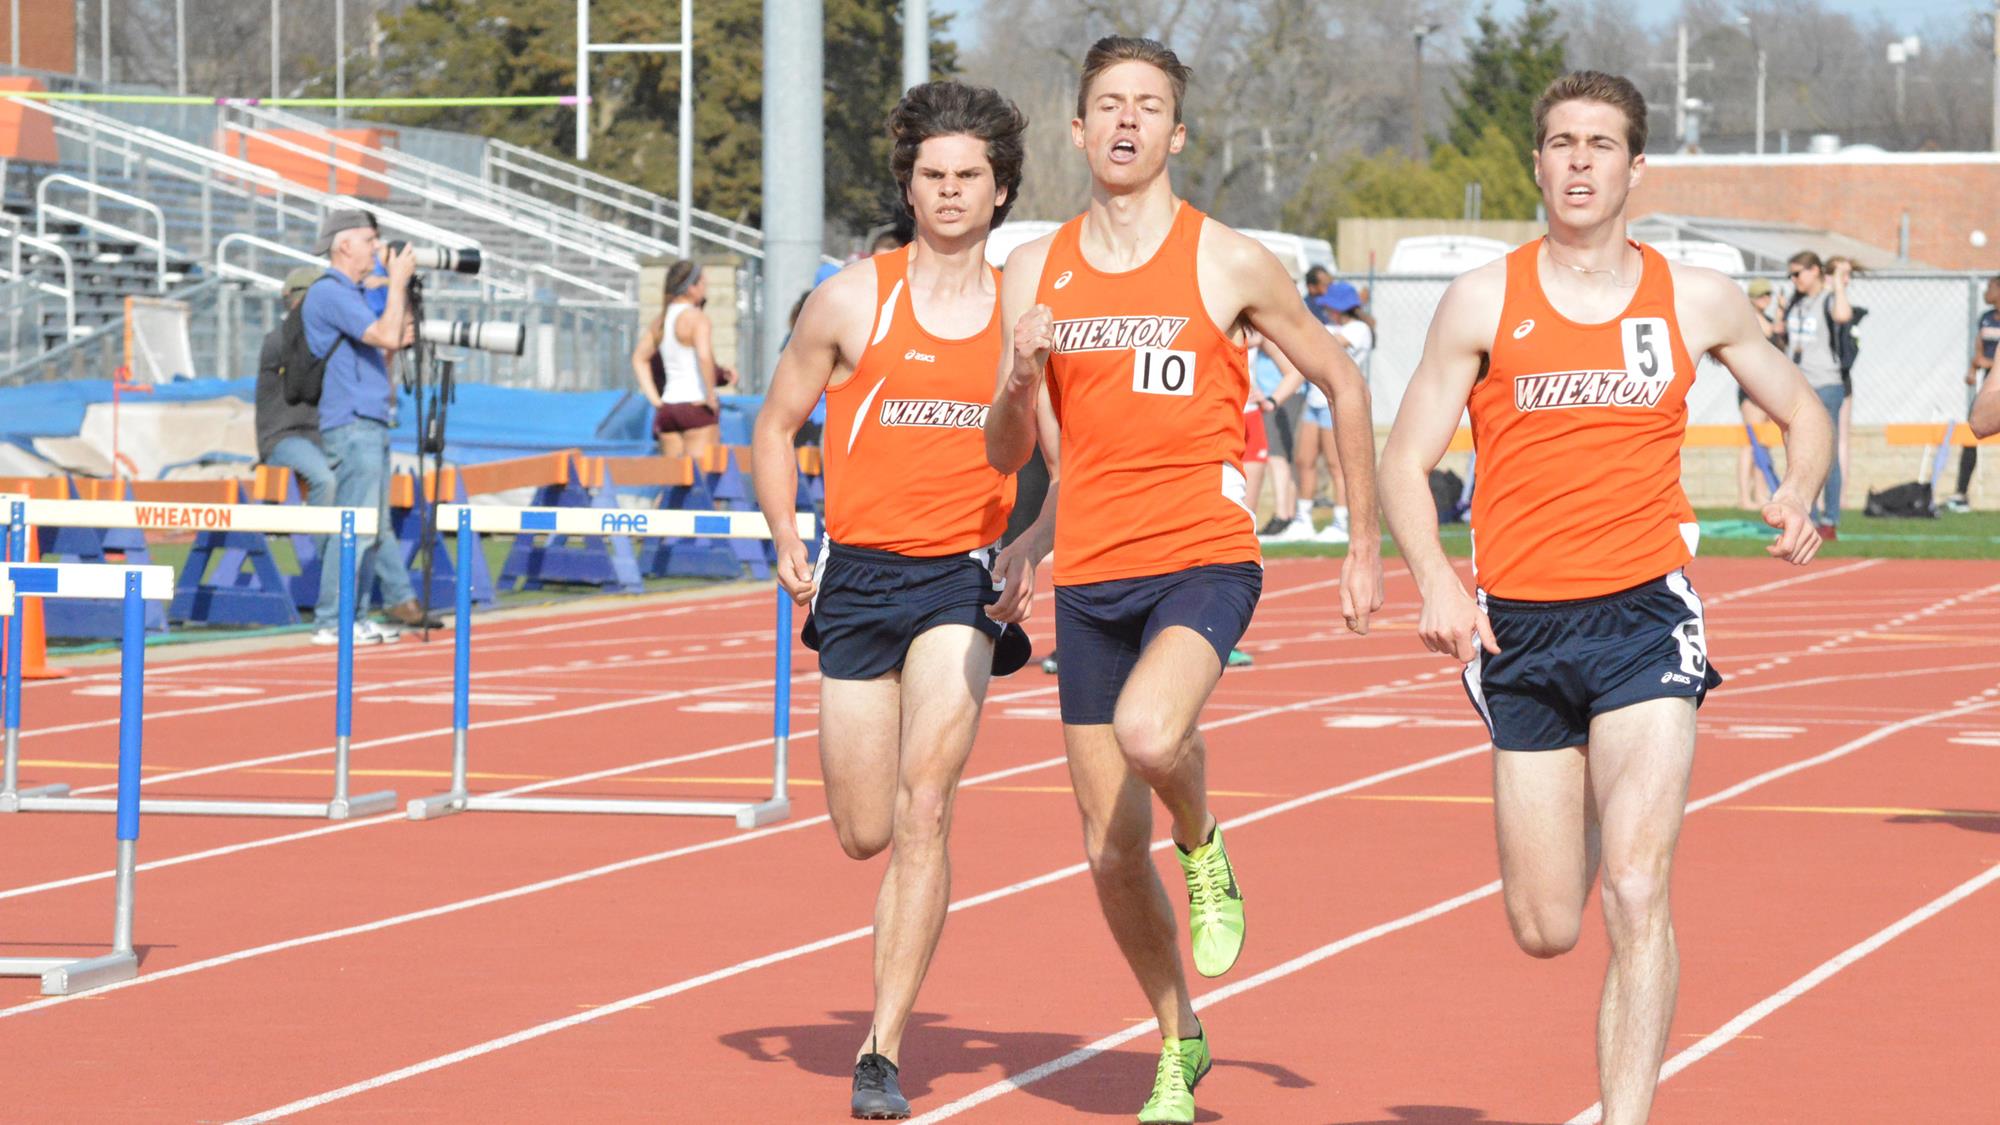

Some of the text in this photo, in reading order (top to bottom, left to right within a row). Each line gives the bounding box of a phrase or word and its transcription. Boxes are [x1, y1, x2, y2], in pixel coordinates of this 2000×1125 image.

[1635, 323, 1659, 378] 5
[1142, 351, 1187, 392] 10
[135, 506, 233, 528] WHEATON
